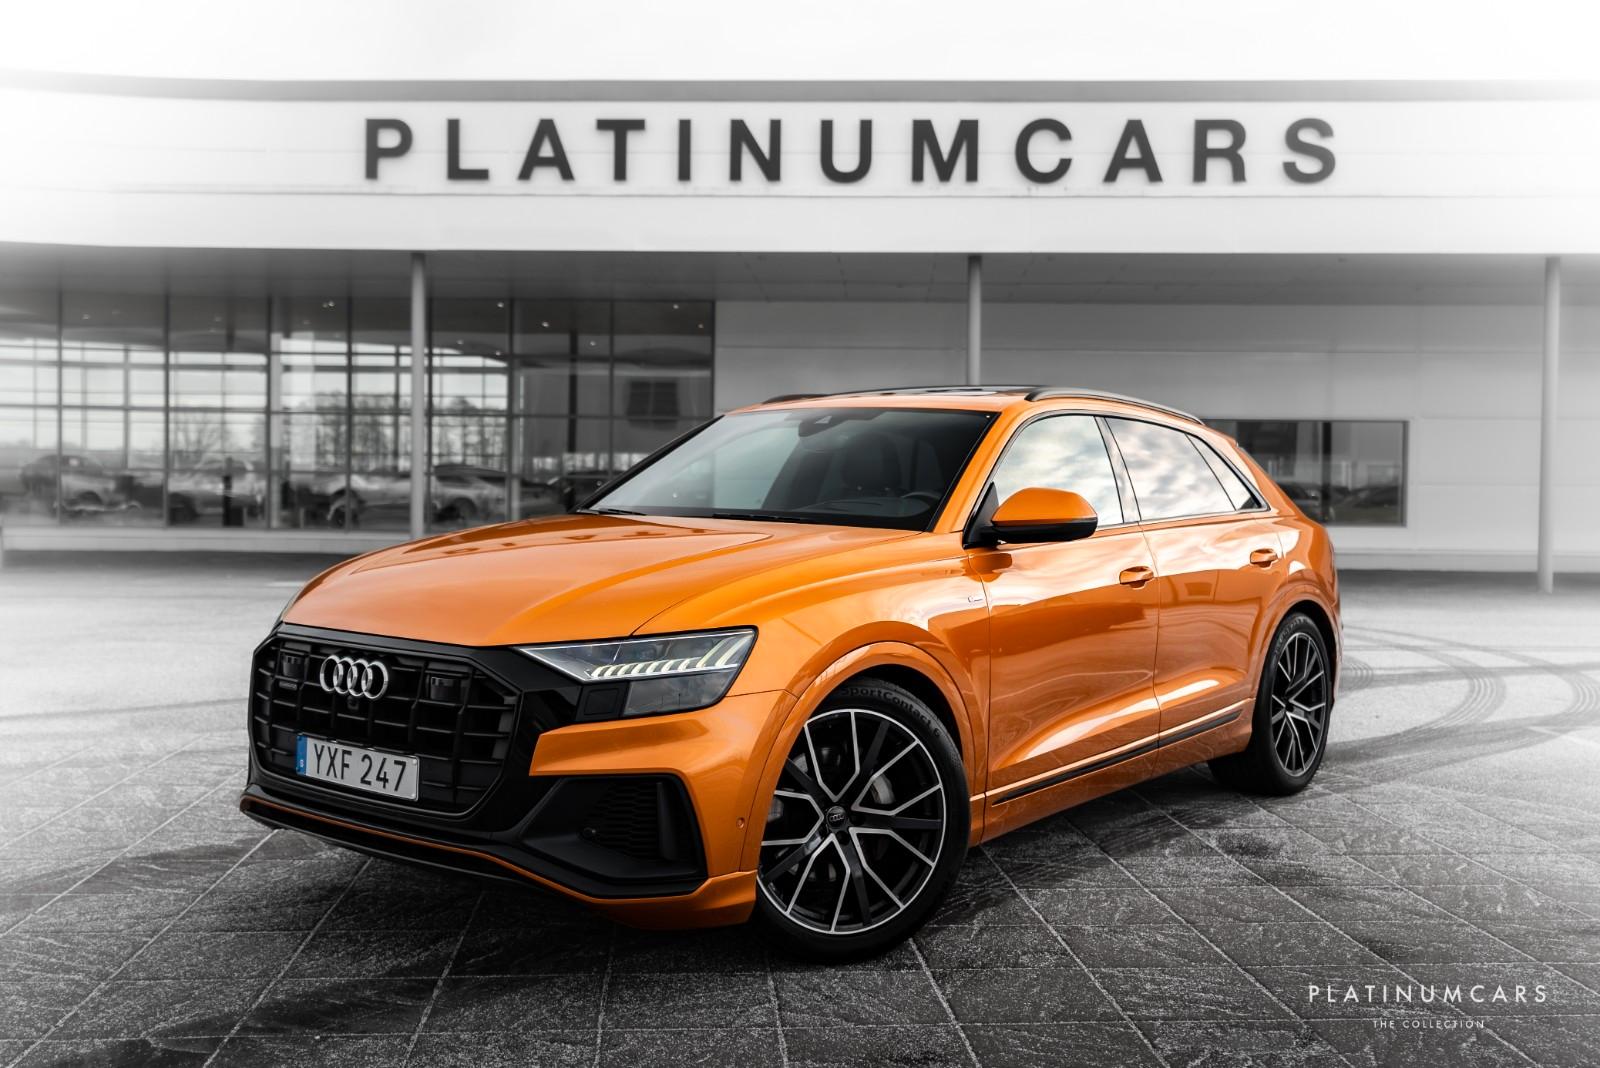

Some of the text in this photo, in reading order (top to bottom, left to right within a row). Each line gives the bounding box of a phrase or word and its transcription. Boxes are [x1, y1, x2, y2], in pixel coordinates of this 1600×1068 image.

[365, 118, 1336, 184] PLATINUMCARS
[841, 686, 932, 728] SportContact
[314, 743, 407, 792] YXF 247
